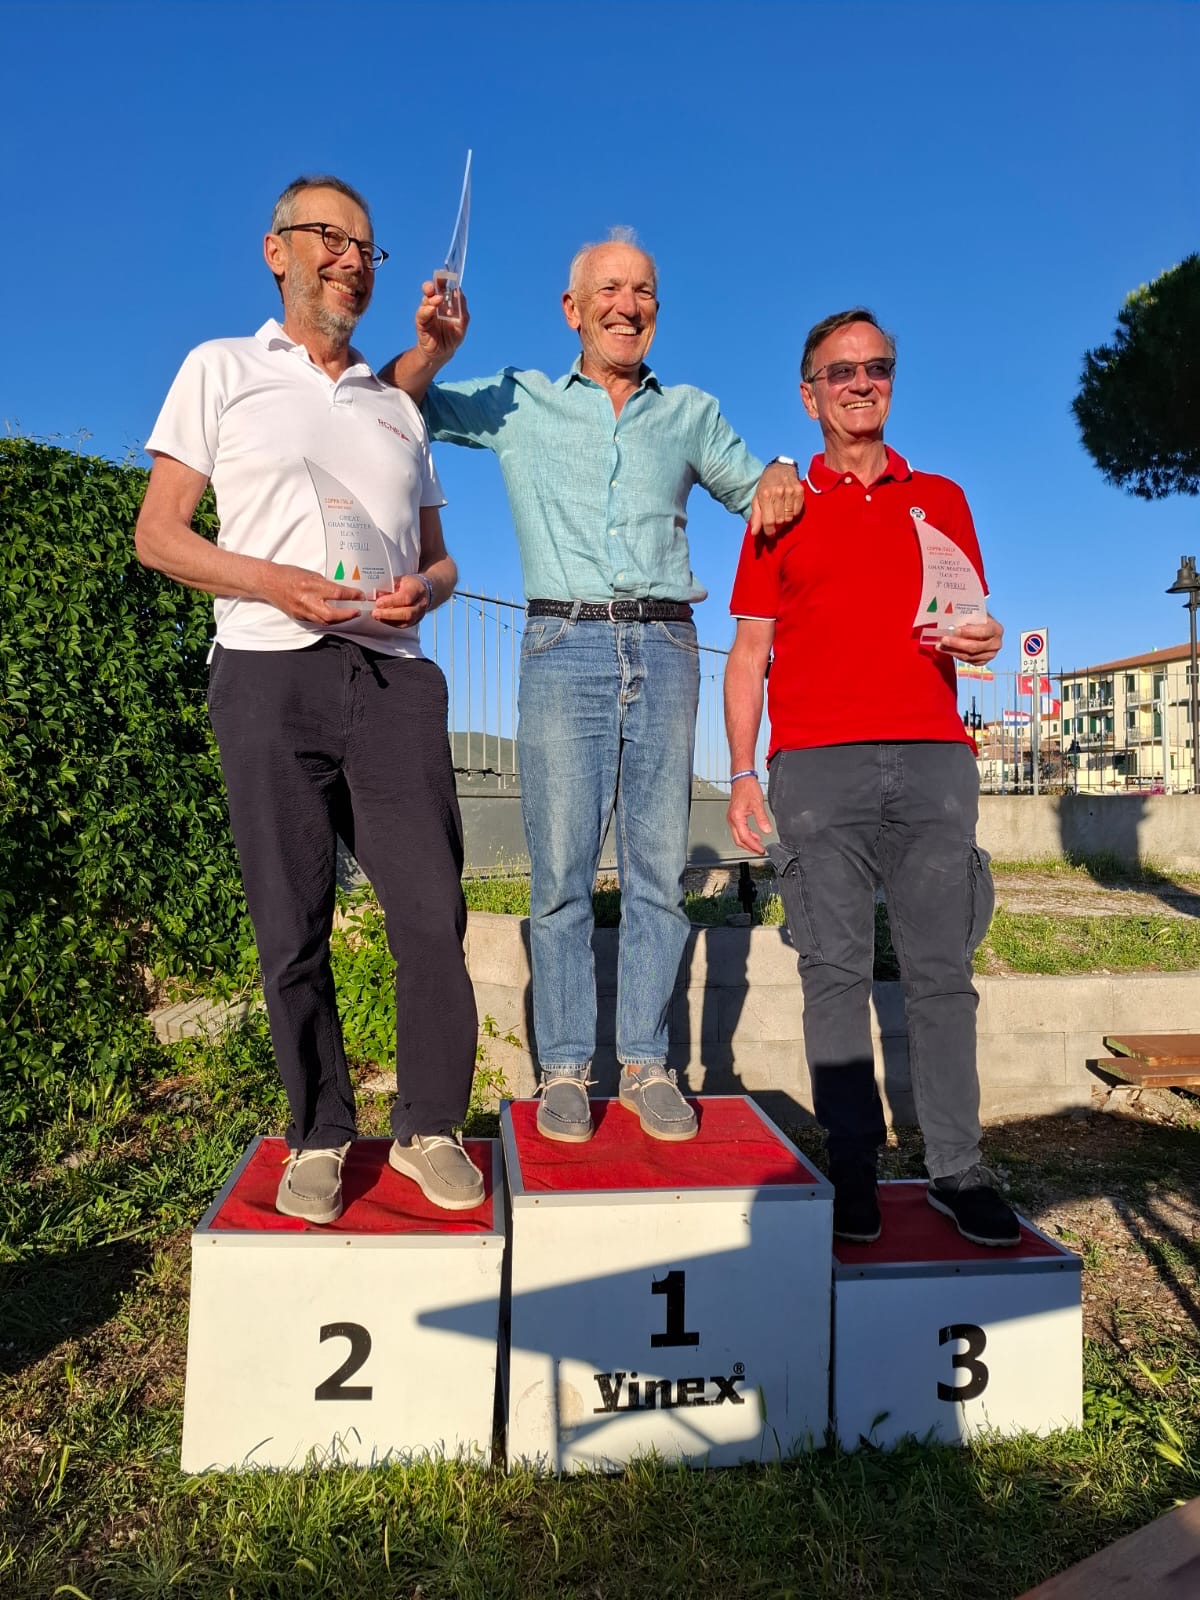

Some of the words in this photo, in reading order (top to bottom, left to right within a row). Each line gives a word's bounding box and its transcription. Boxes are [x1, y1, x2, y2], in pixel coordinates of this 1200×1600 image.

[348, 542, 370, 551] OVERALL
[943, 581, 967, 590] OVERALL
[649, 1270, 700, 1349] 1
[314, 1321, 374, 1401] 2
[935, 1323, 990, 1402] 3
